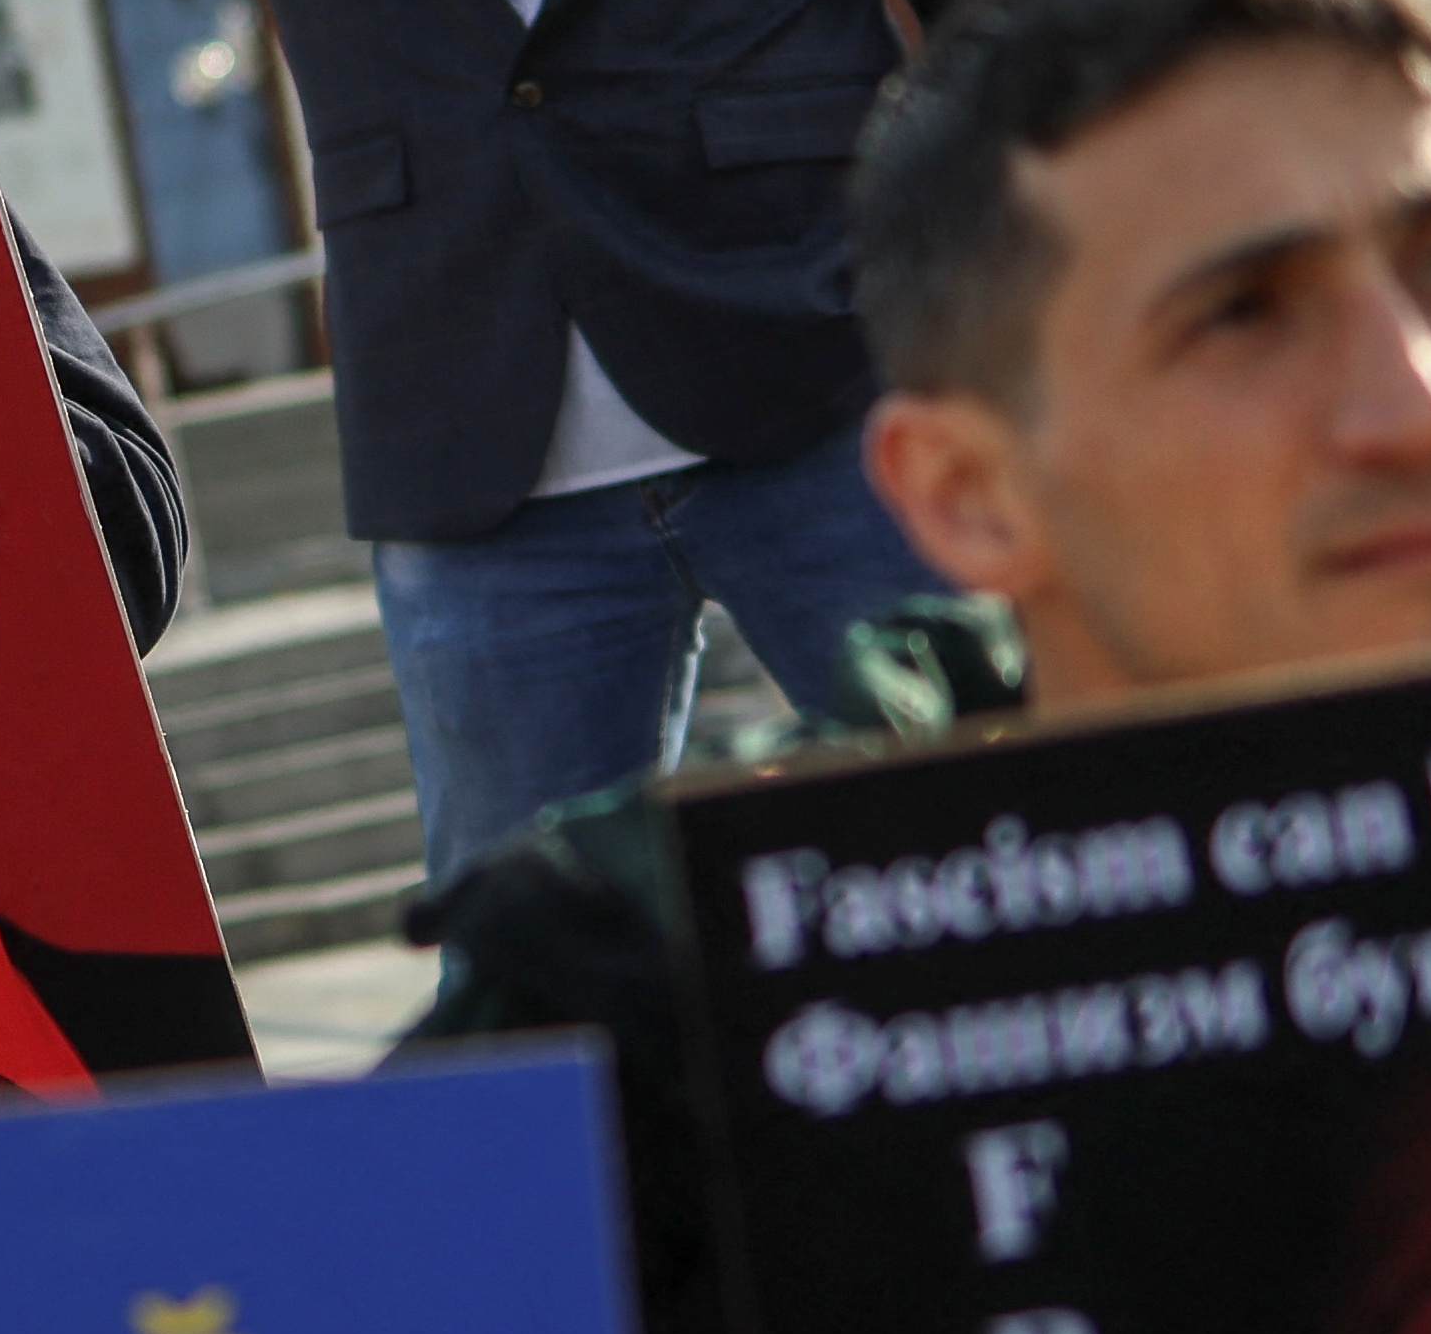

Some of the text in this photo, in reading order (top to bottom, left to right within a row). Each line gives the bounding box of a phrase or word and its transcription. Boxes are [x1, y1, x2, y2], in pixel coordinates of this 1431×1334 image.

[742, 815, 1191, 968] Fascism
[1209, 783, 1414, 891] can
[766, 961, 1265, 1113] Фашизм
